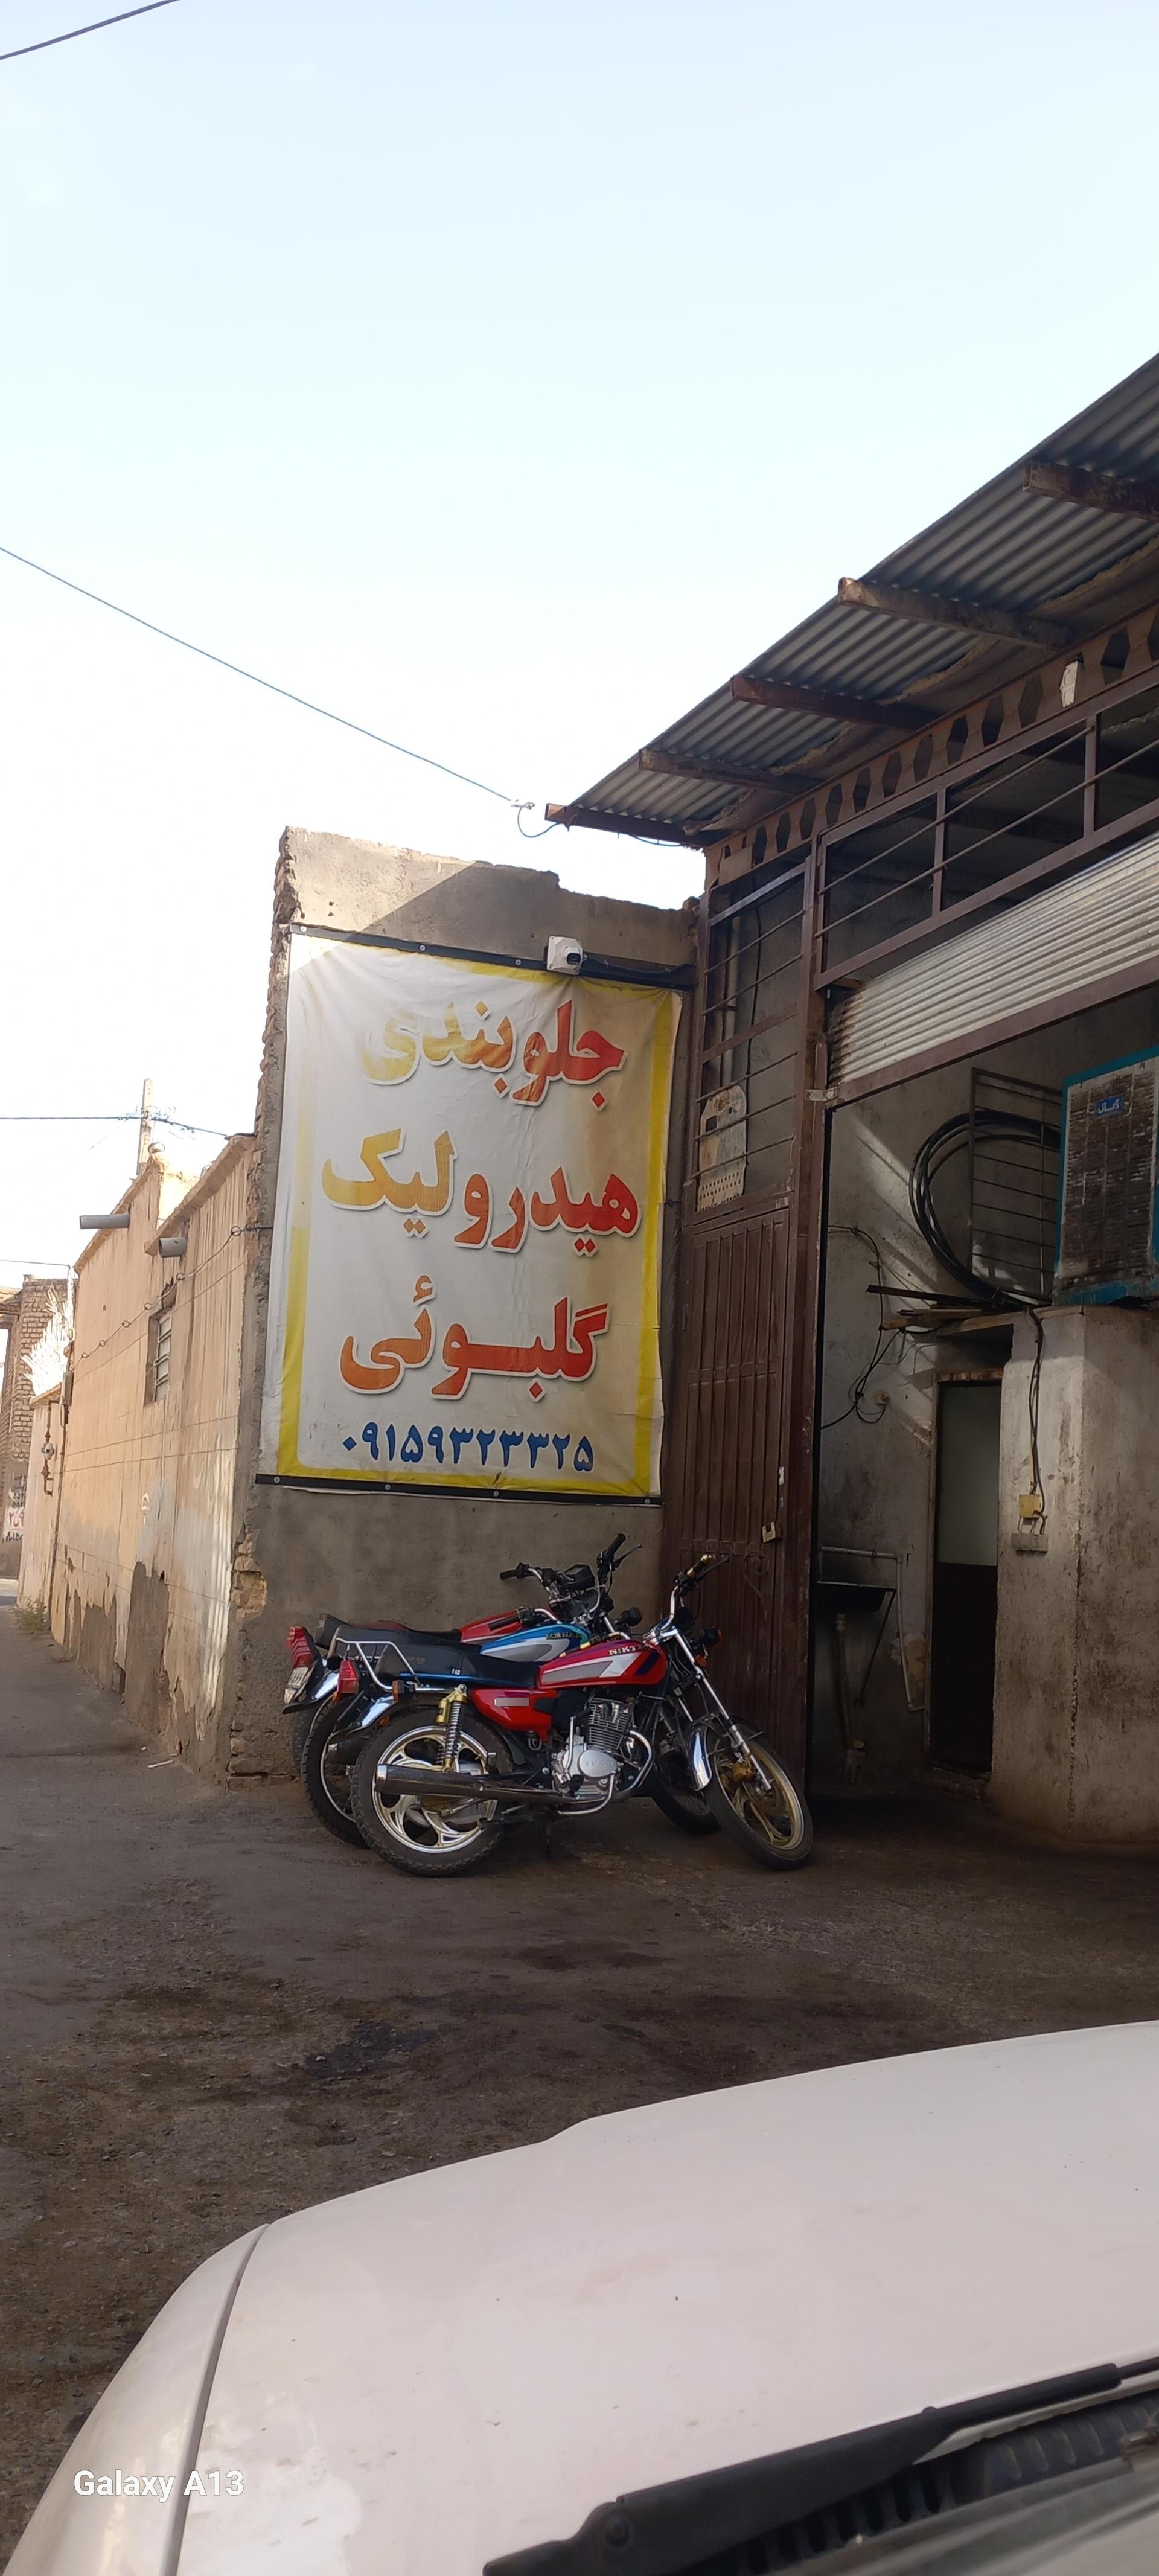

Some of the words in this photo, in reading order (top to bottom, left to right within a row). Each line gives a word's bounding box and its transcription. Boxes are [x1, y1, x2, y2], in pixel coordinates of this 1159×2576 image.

[362, 999, 626, 1110] جلوبندی
[321, 1128, 639, 1253] هیدرولیک
[340, 1274, 608, 1399] گلبوئی
[342, 1421, 594, 1472] ۰۹۱۵۹۳۲۳۳۲۵
